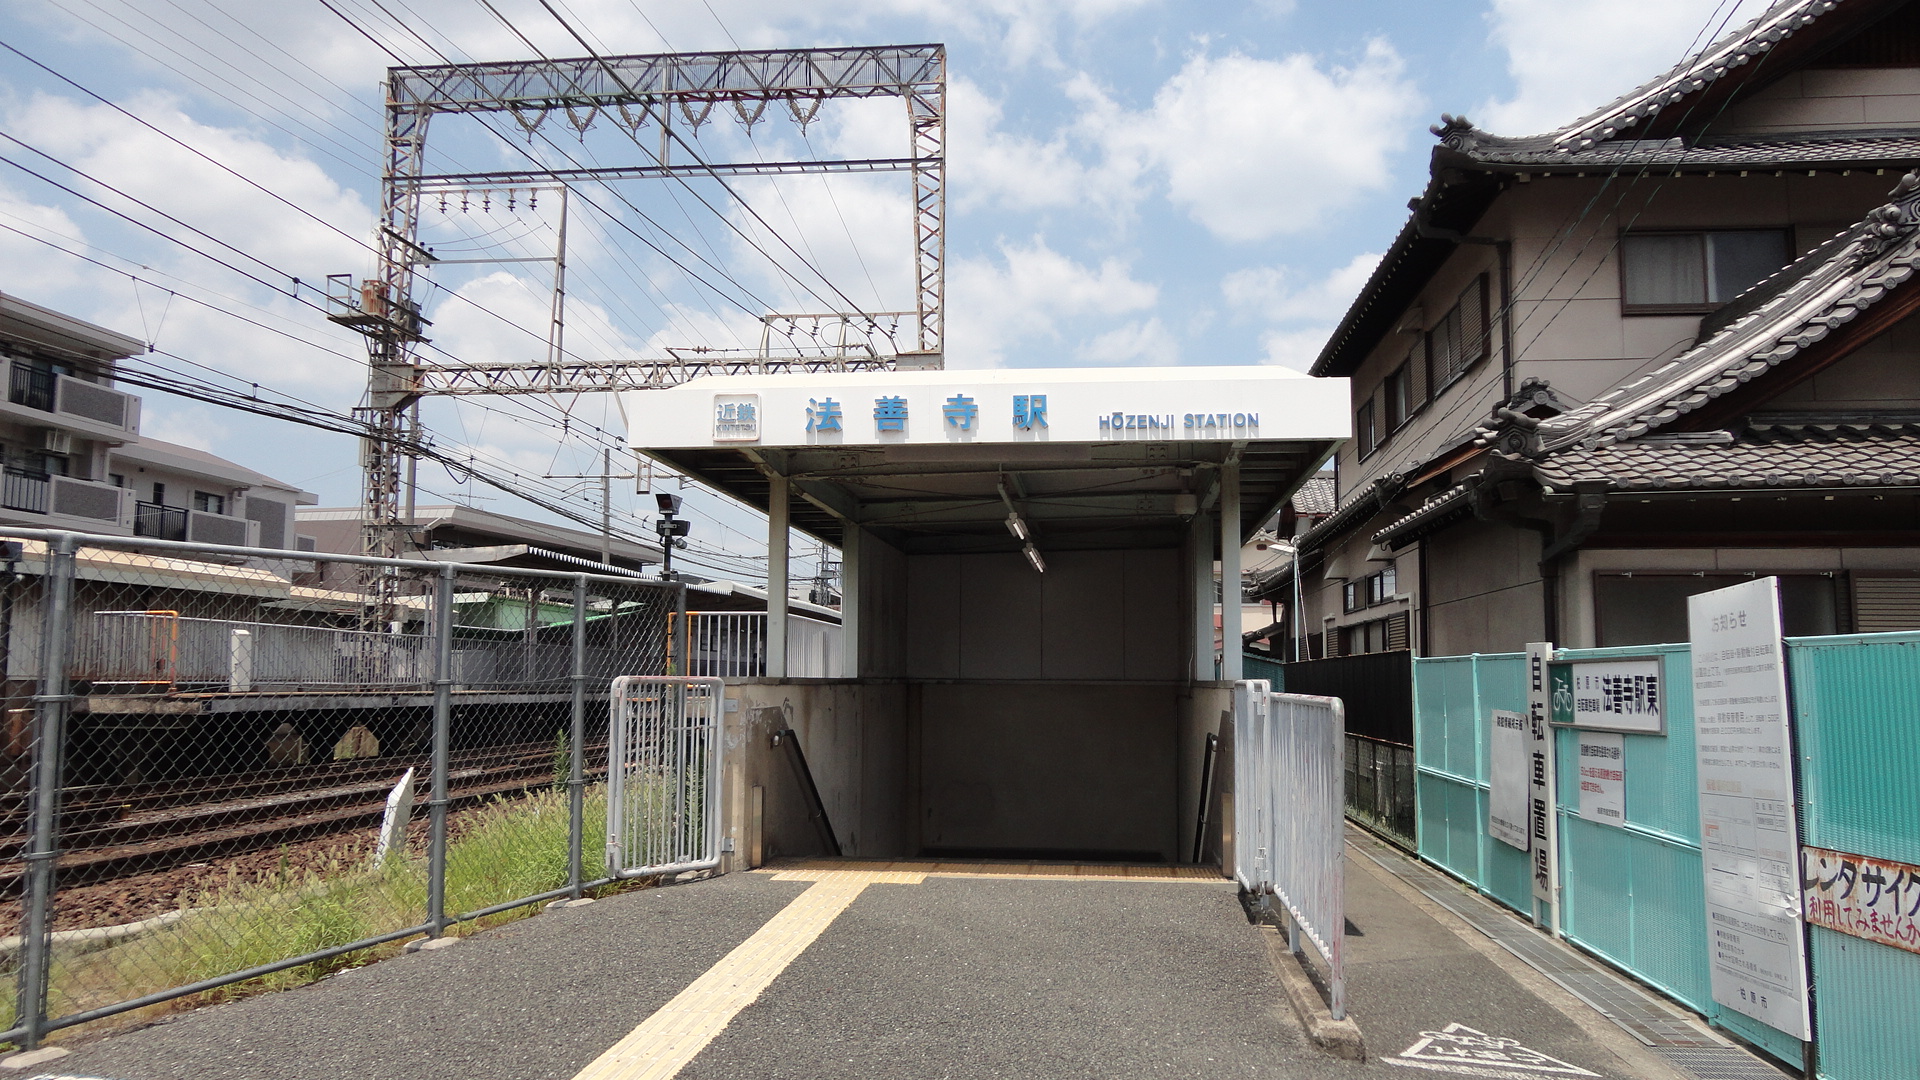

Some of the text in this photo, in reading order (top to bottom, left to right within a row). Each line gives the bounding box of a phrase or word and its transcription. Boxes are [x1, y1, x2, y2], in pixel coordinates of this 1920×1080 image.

[715, 423, 757, 432] KINTETSU
[716, 402, 757, 423] 近鉄
[805, 393, 1048, 433] 法善寺駅
[1098, 411, 1259, 430] HŌZENJI STATION
[1711, 610, 1748, 632] お知らせ
[1602, 673, 1659, 716] 法善寺駅東
[1531, 652, 1548, 892] 自転車置場
[1809, 896, 1920, 945] 利用してみませんか
